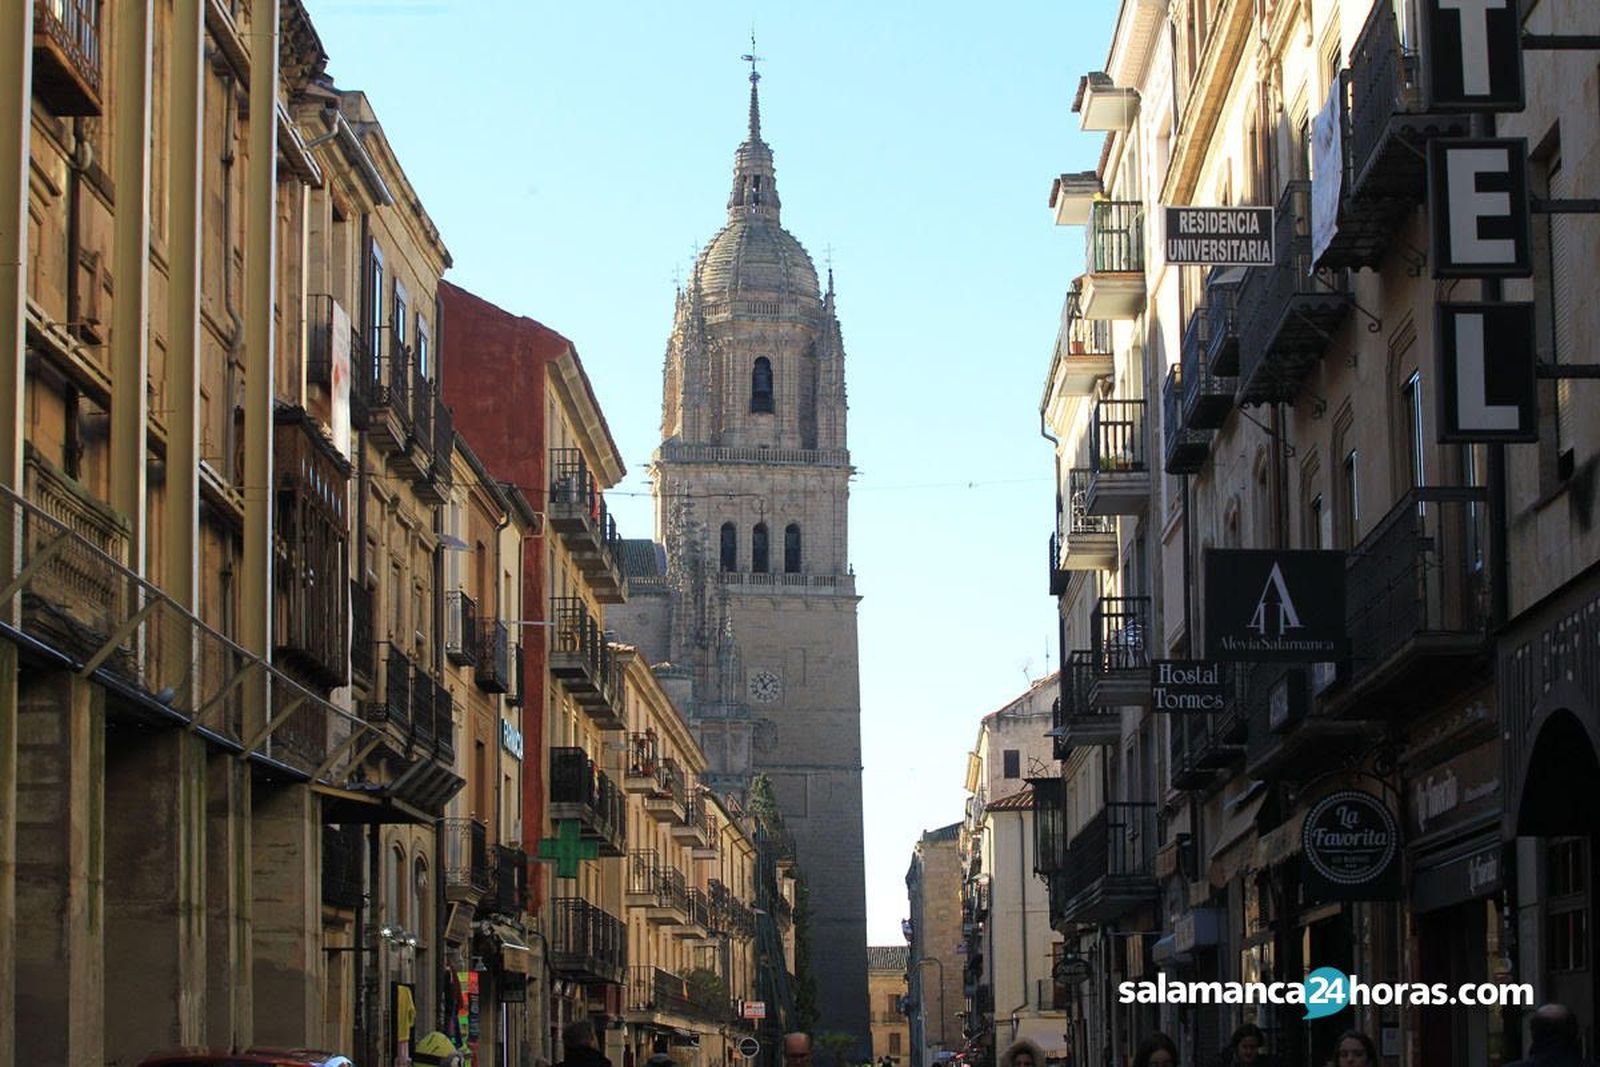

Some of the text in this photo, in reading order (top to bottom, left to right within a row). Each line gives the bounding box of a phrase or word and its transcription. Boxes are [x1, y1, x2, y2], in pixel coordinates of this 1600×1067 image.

[1178, 210, 1260, 234] RESIDENCIA
[1167, 238, 1271, 262] UNIVERSITARIA
[1159, 663, 1218, 685] Hostal
[1153, 687, 1224, 710] Tormes
[1336, 805, 1360, 829] La
[1312, 828, 1388, 847] Favorita
